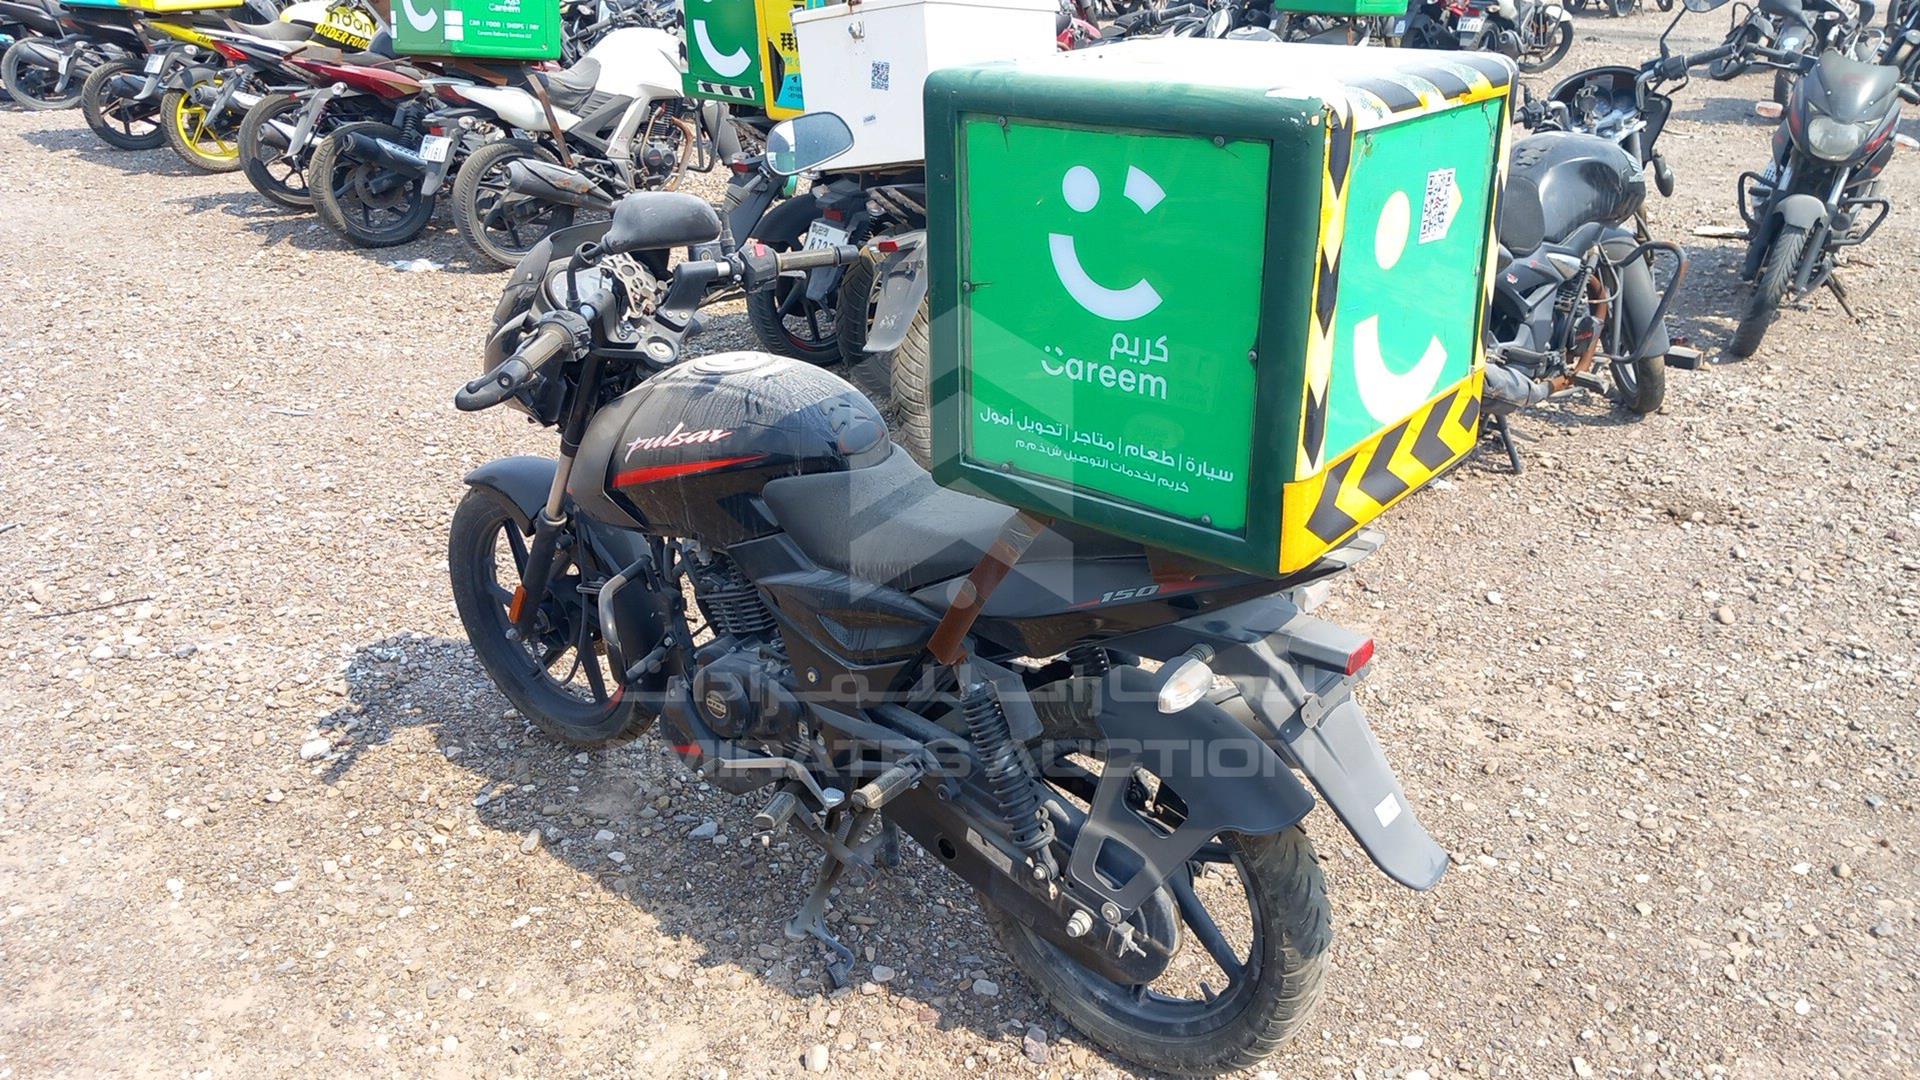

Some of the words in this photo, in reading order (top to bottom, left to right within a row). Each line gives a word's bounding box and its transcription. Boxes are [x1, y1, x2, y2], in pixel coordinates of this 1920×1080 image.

[315, 23, 347, 44] ORDER
[1109, 332, 1169, 366] كريم
[1041, 345, 1168, 400] Careem
[1016, 415, 1062, 437] تحويل
[624, 422, 733, 464] pulsar
[1072, 430, 1115, 451] متاجر
[1063, 449, 1109, 470] التوصيل
[1124, 443, 1175, 468] طعام
[1110, 461, 1157, 483] لخدمات
[1186, 456, 1235, 483] سيارة
[1157, 476, 1190, 494] كريم
[1101, 585, 1160, 603] 150
